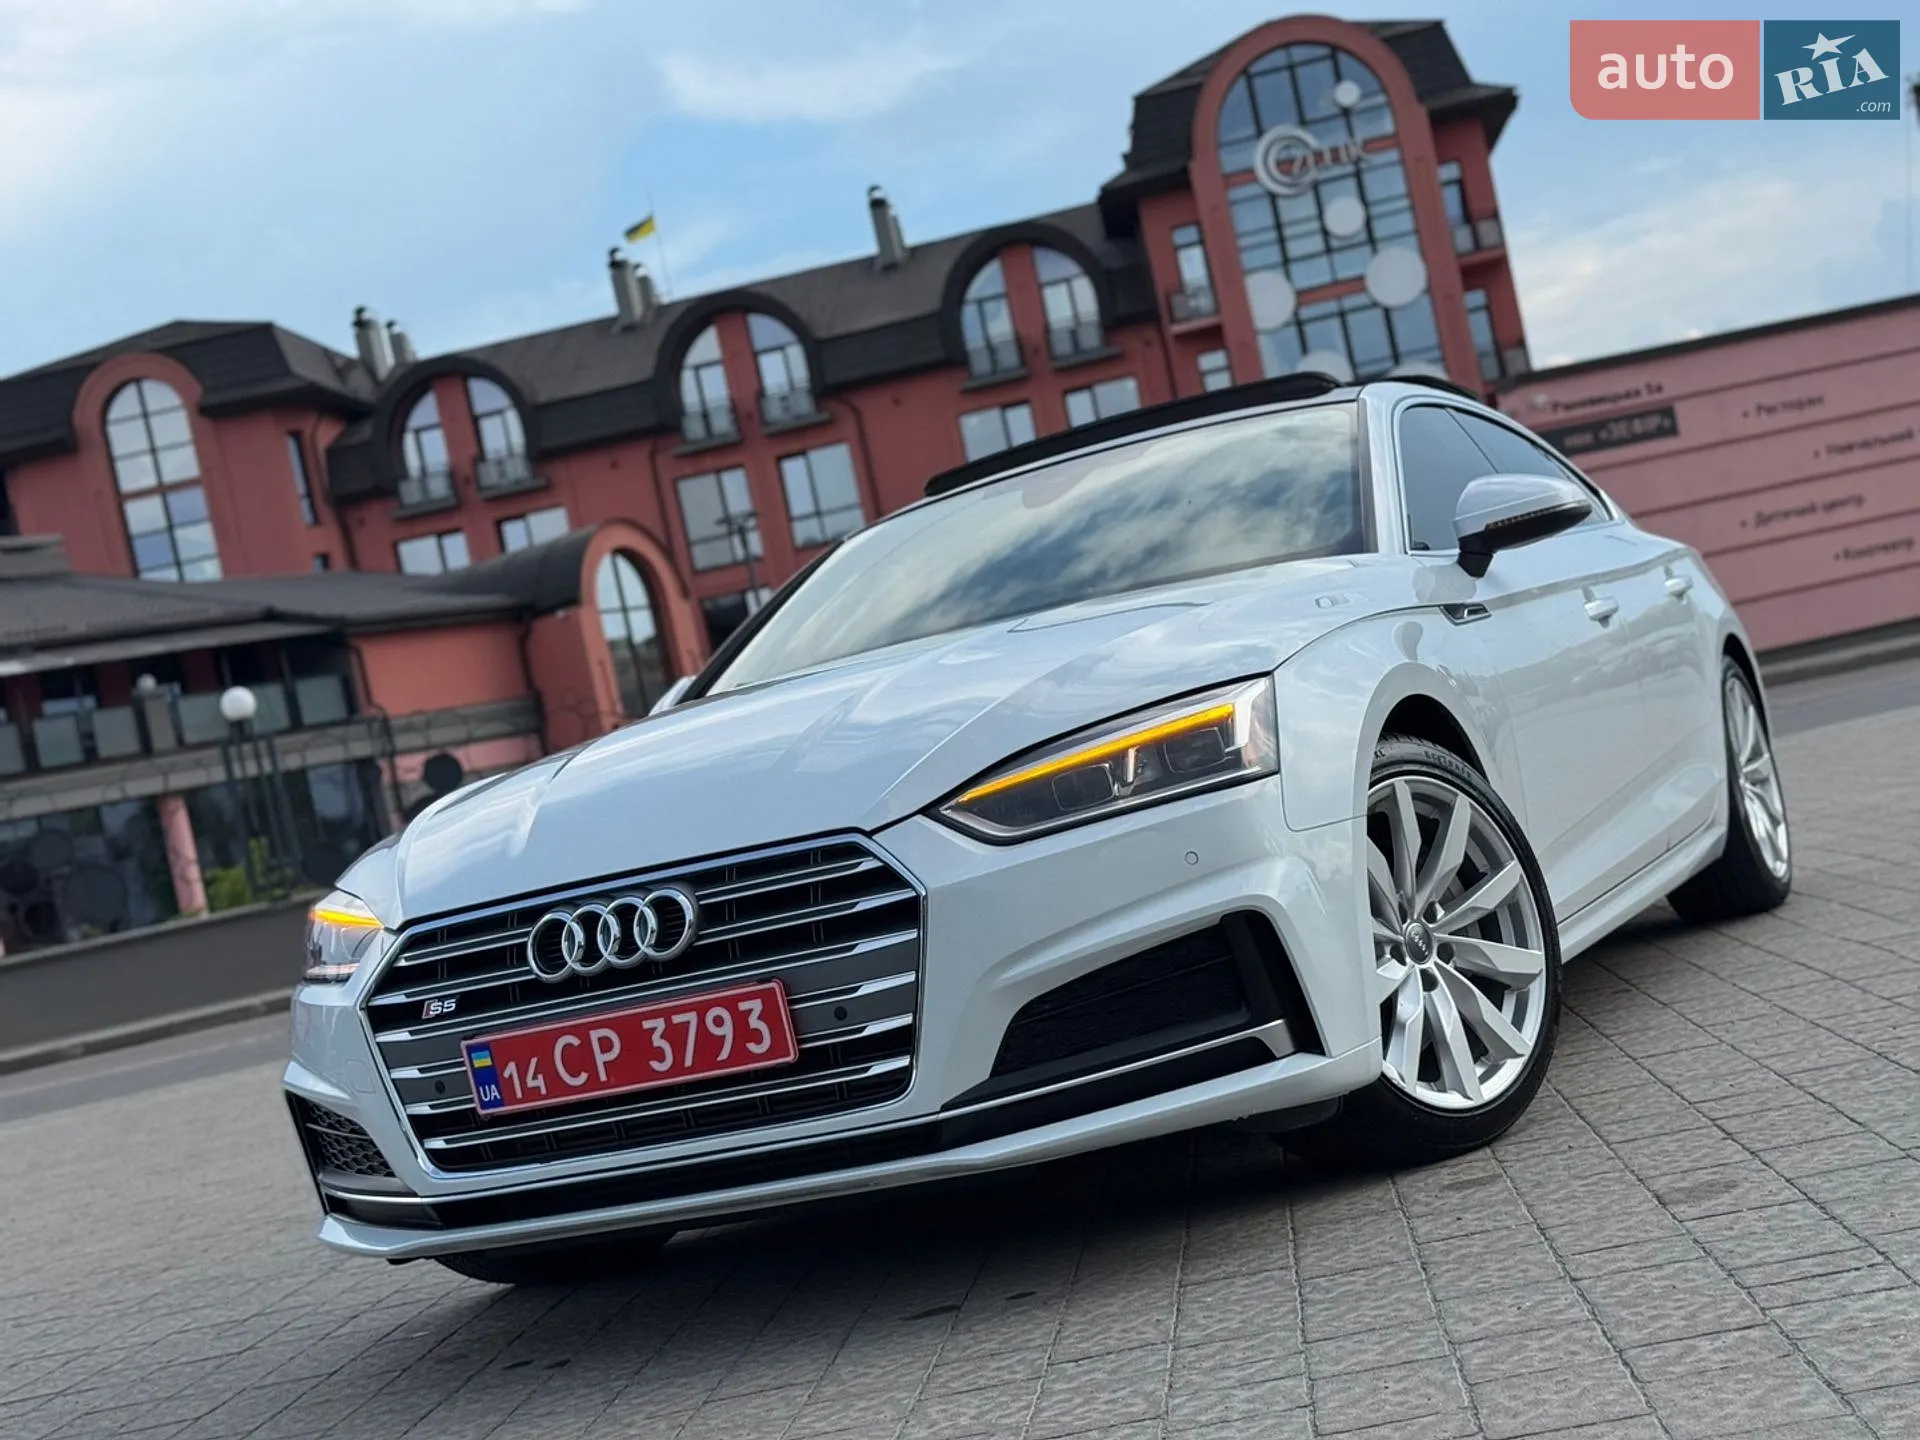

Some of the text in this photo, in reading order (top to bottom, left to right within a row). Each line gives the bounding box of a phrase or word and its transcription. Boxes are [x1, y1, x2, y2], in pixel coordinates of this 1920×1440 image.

[429, 999, 456, 1014] S5
[503, 999, 771, 1098] 14 CP 3793
[479, 1084, 500, 1101] UA
